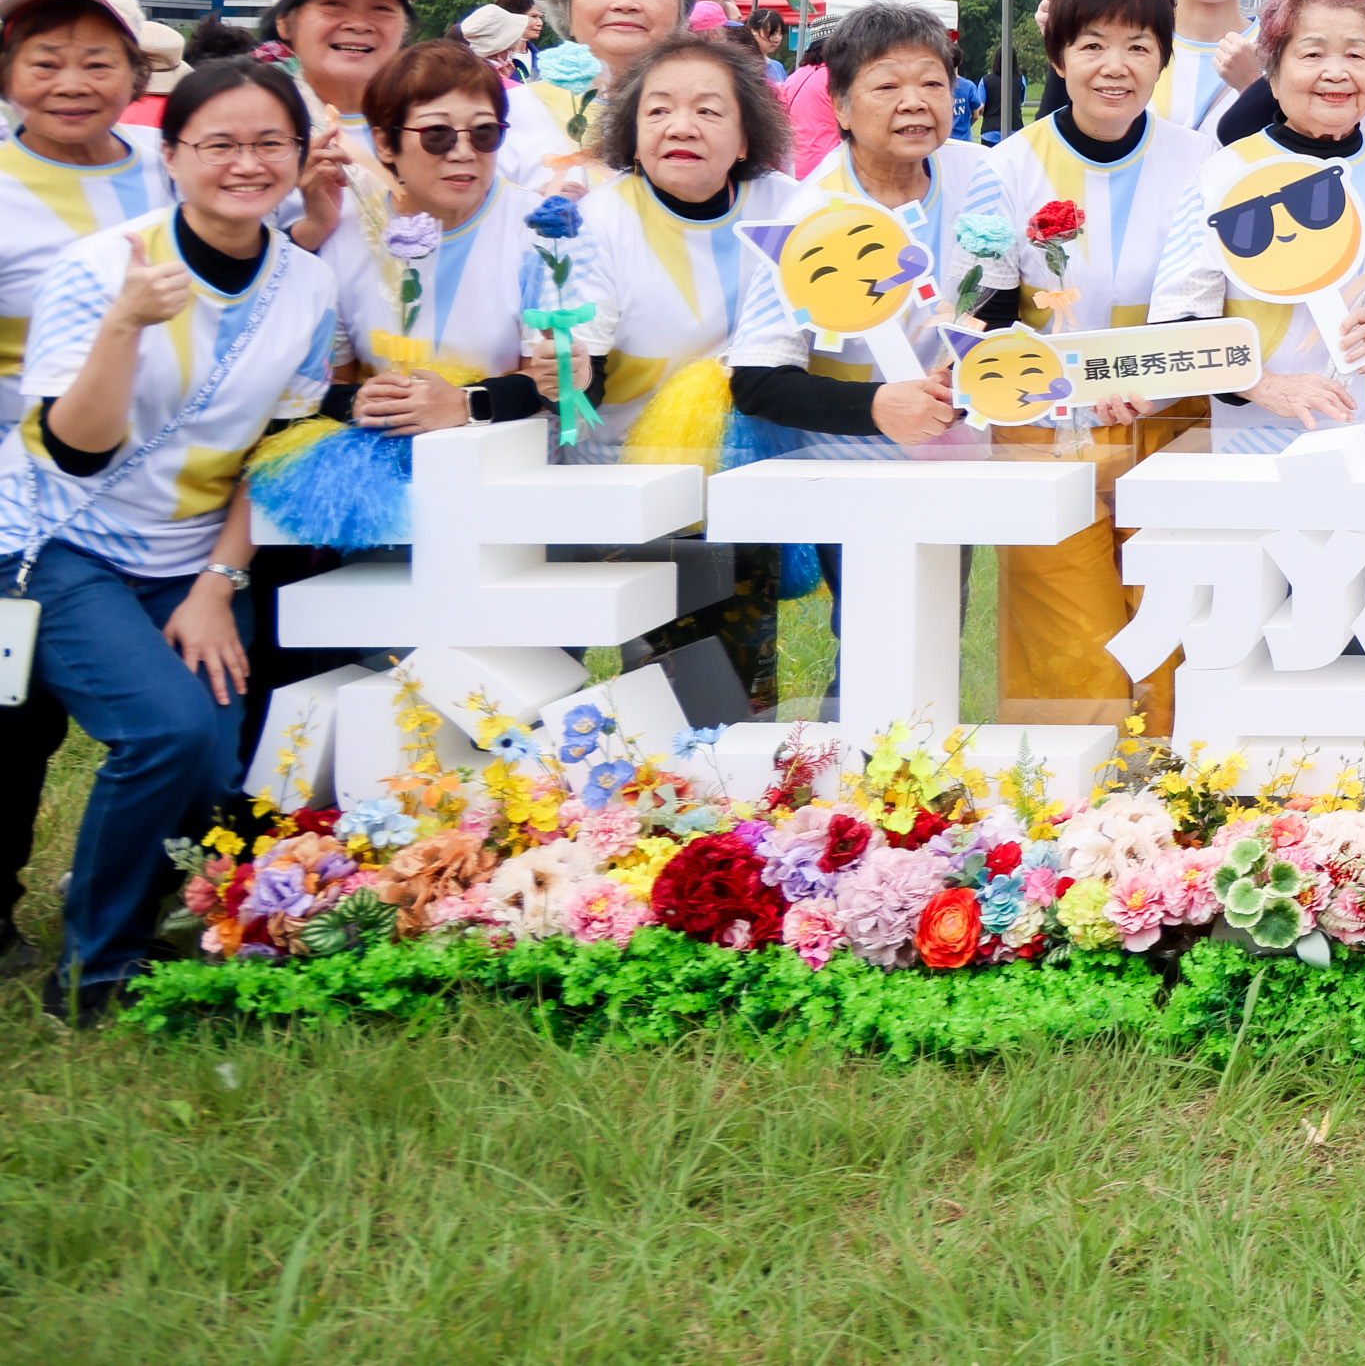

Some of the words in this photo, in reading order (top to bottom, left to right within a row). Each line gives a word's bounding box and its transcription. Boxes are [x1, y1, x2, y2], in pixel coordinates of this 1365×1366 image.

[1083, 344, 1252, 382] 最優秀志工隊
